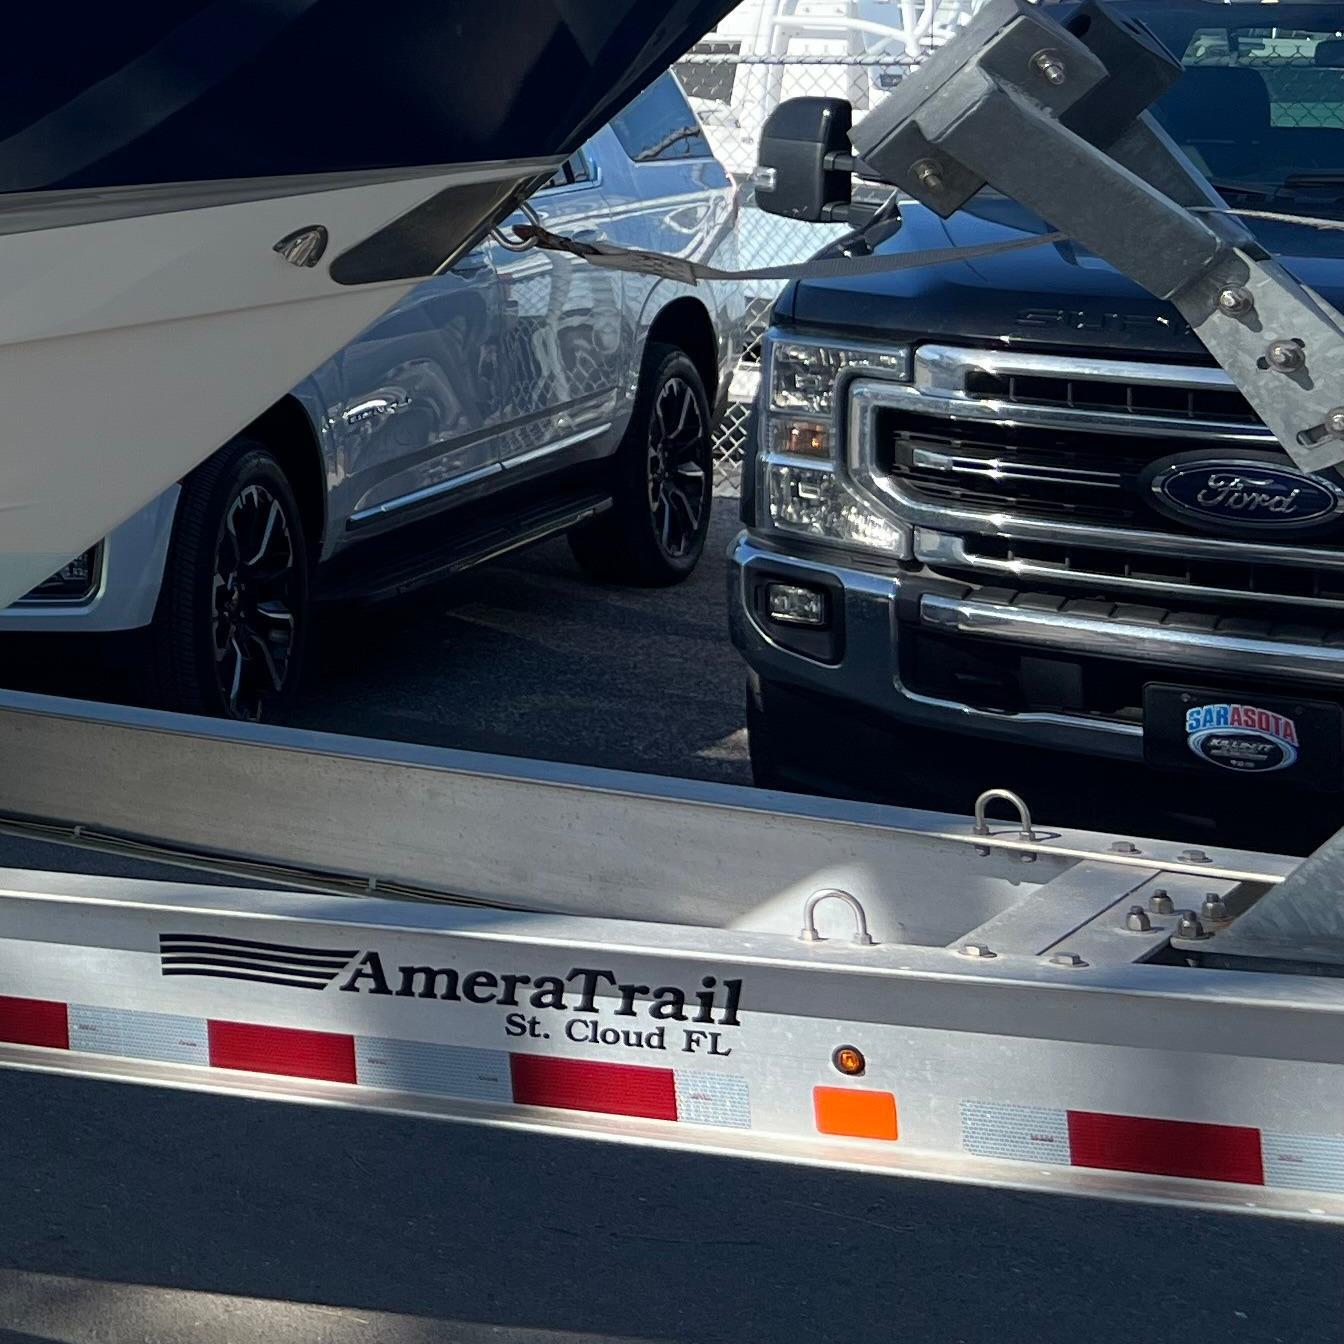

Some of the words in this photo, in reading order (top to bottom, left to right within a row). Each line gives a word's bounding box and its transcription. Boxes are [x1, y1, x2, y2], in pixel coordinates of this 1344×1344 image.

[1197, 473, 1300, 513] Ford
[1187, 705, 1298, 746] SARASOTA
[338, 950, 743, 1027] AmeraTrail
[505, 1013, 550, 1040] St.
[565, 1020, 666, 1051] Cloud
[681, 1030, 733, 1057] FL
